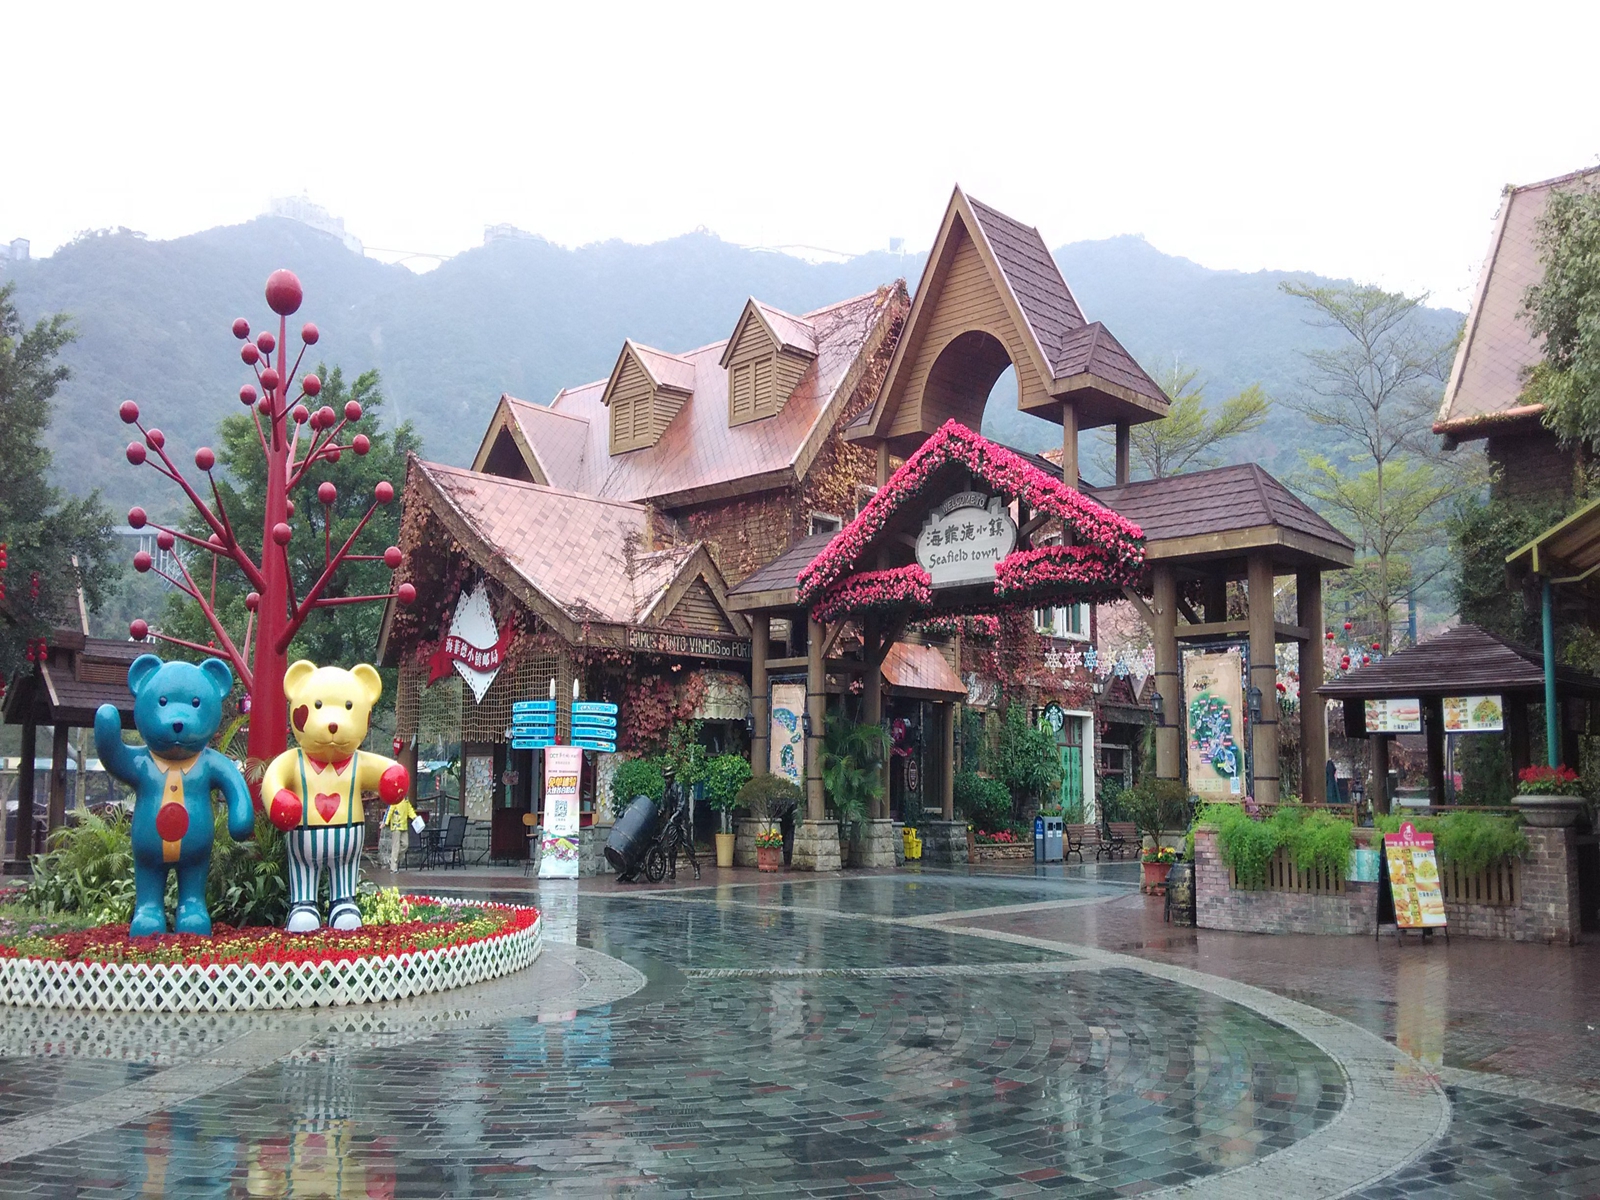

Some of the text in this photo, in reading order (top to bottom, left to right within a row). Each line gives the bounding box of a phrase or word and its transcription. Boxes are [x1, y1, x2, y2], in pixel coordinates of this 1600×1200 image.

[929, 547, 1001, 569] Seafield town
[689, 637, 721, 655] VINHOS
[732, 641, 753, 658] PORT
